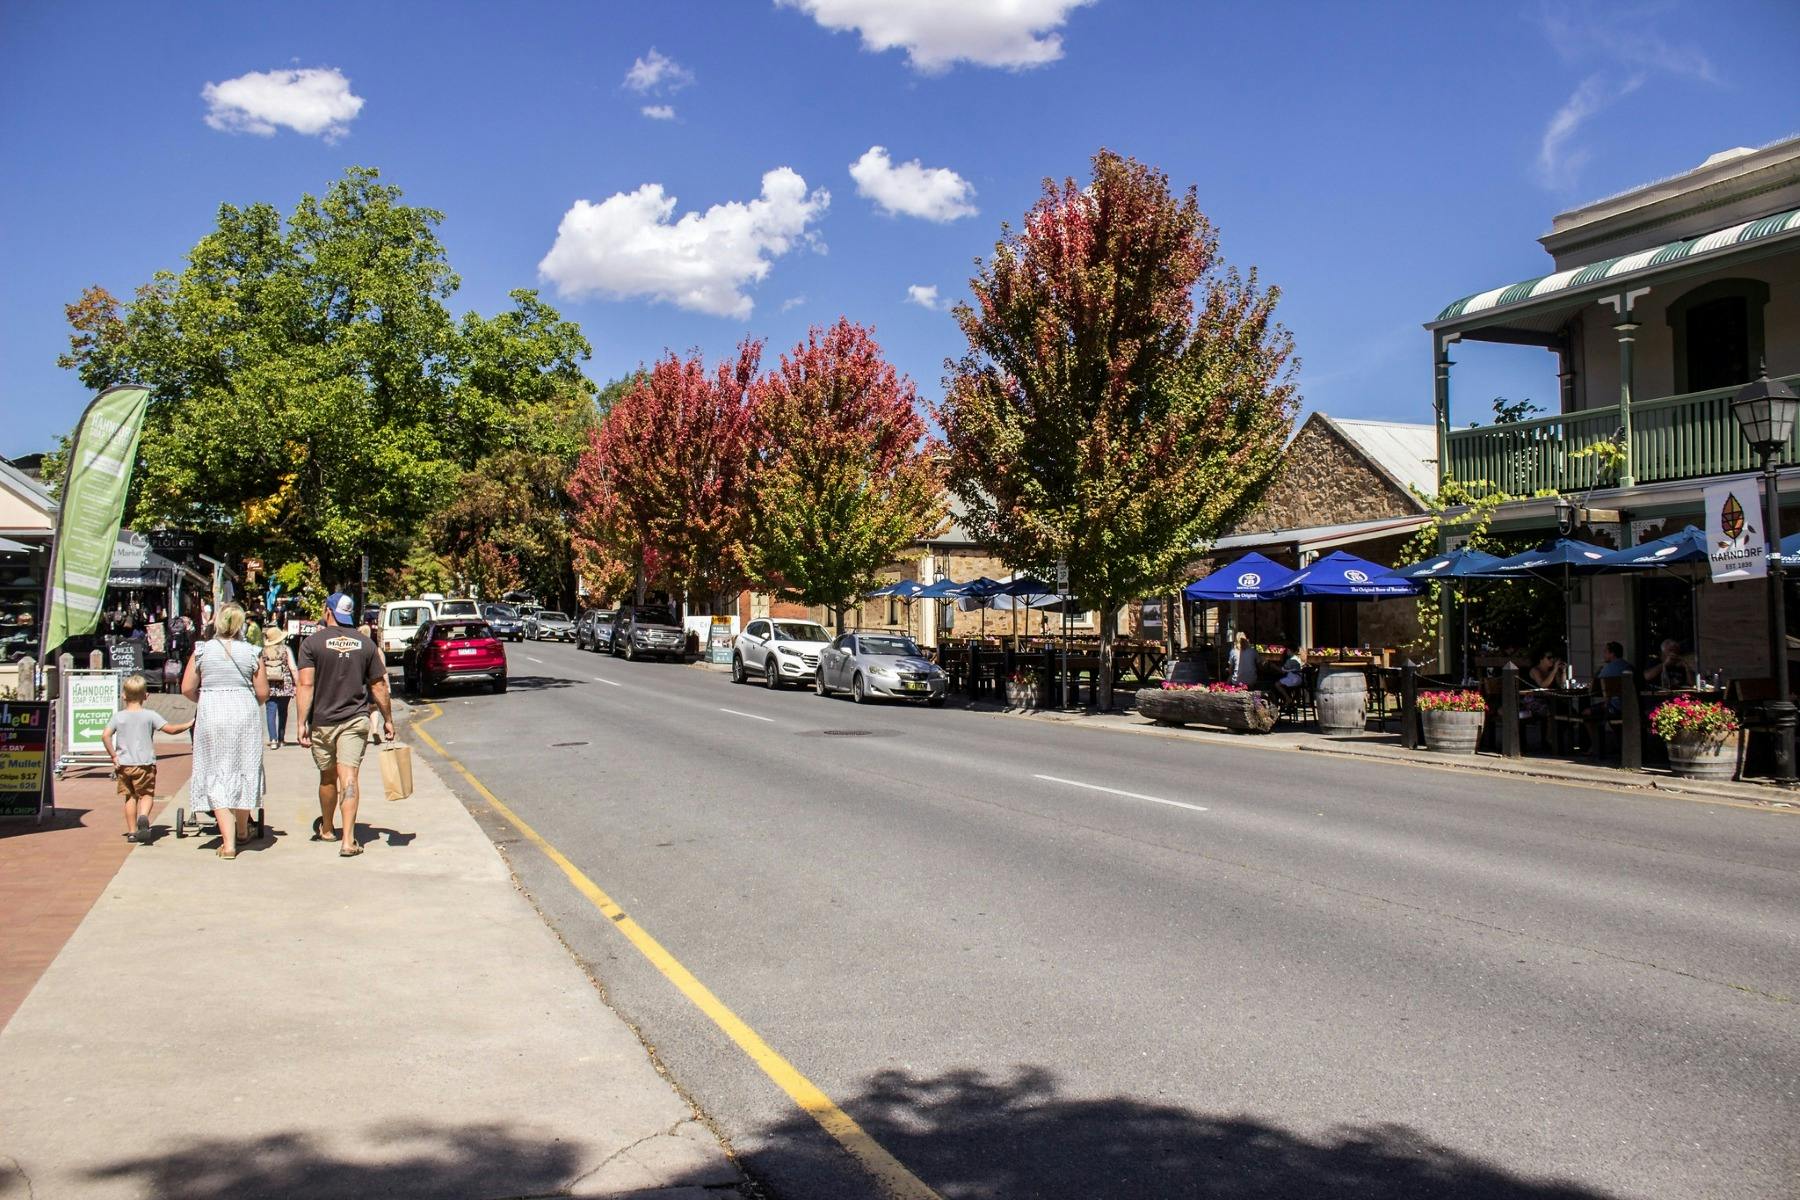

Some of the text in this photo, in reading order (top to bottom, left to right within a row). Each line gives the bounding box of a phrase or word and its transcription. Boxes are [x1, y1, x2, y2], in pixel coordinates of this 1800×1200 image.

[153, 539, 194, 547] PLOUGH
[117, 549, 141, 557] Market
[1711, 547, 1763, 562] HAHNDORF
[73, 683, 114, 696] HAHNDORF
[0, 703, 40, 727] head
[8, 760, 42, 768] Mullet
